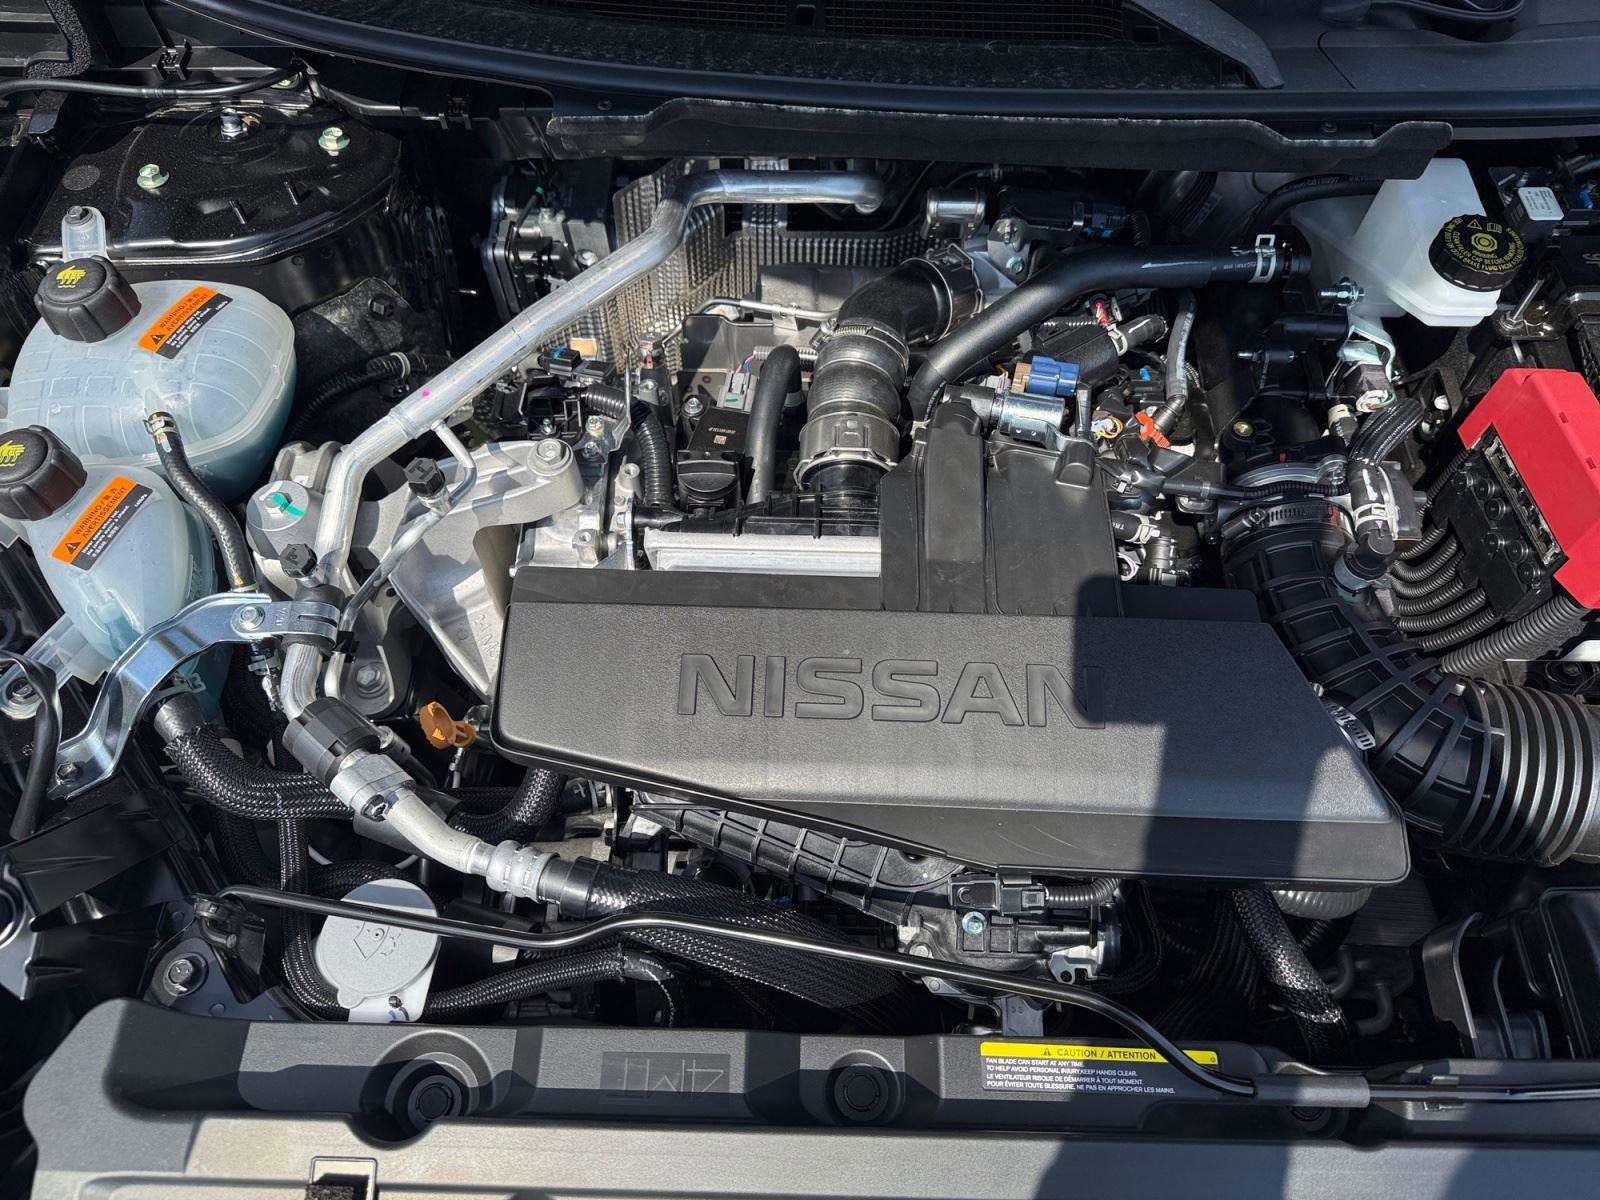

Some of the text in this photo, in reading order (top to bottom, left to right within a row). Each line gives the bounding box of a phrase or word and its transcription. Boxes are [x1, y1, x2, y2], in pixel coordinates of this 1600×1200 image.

[74, 505, 102, 536] WARNING
[83, 487, 127, 538] AVERTISSEMENT
[677, 653, 1106, 729] NISSAN
[1056, 1048, 1097, 1058] CAUTION
[1107, 1050, 1156, 1060] ATTENTION
